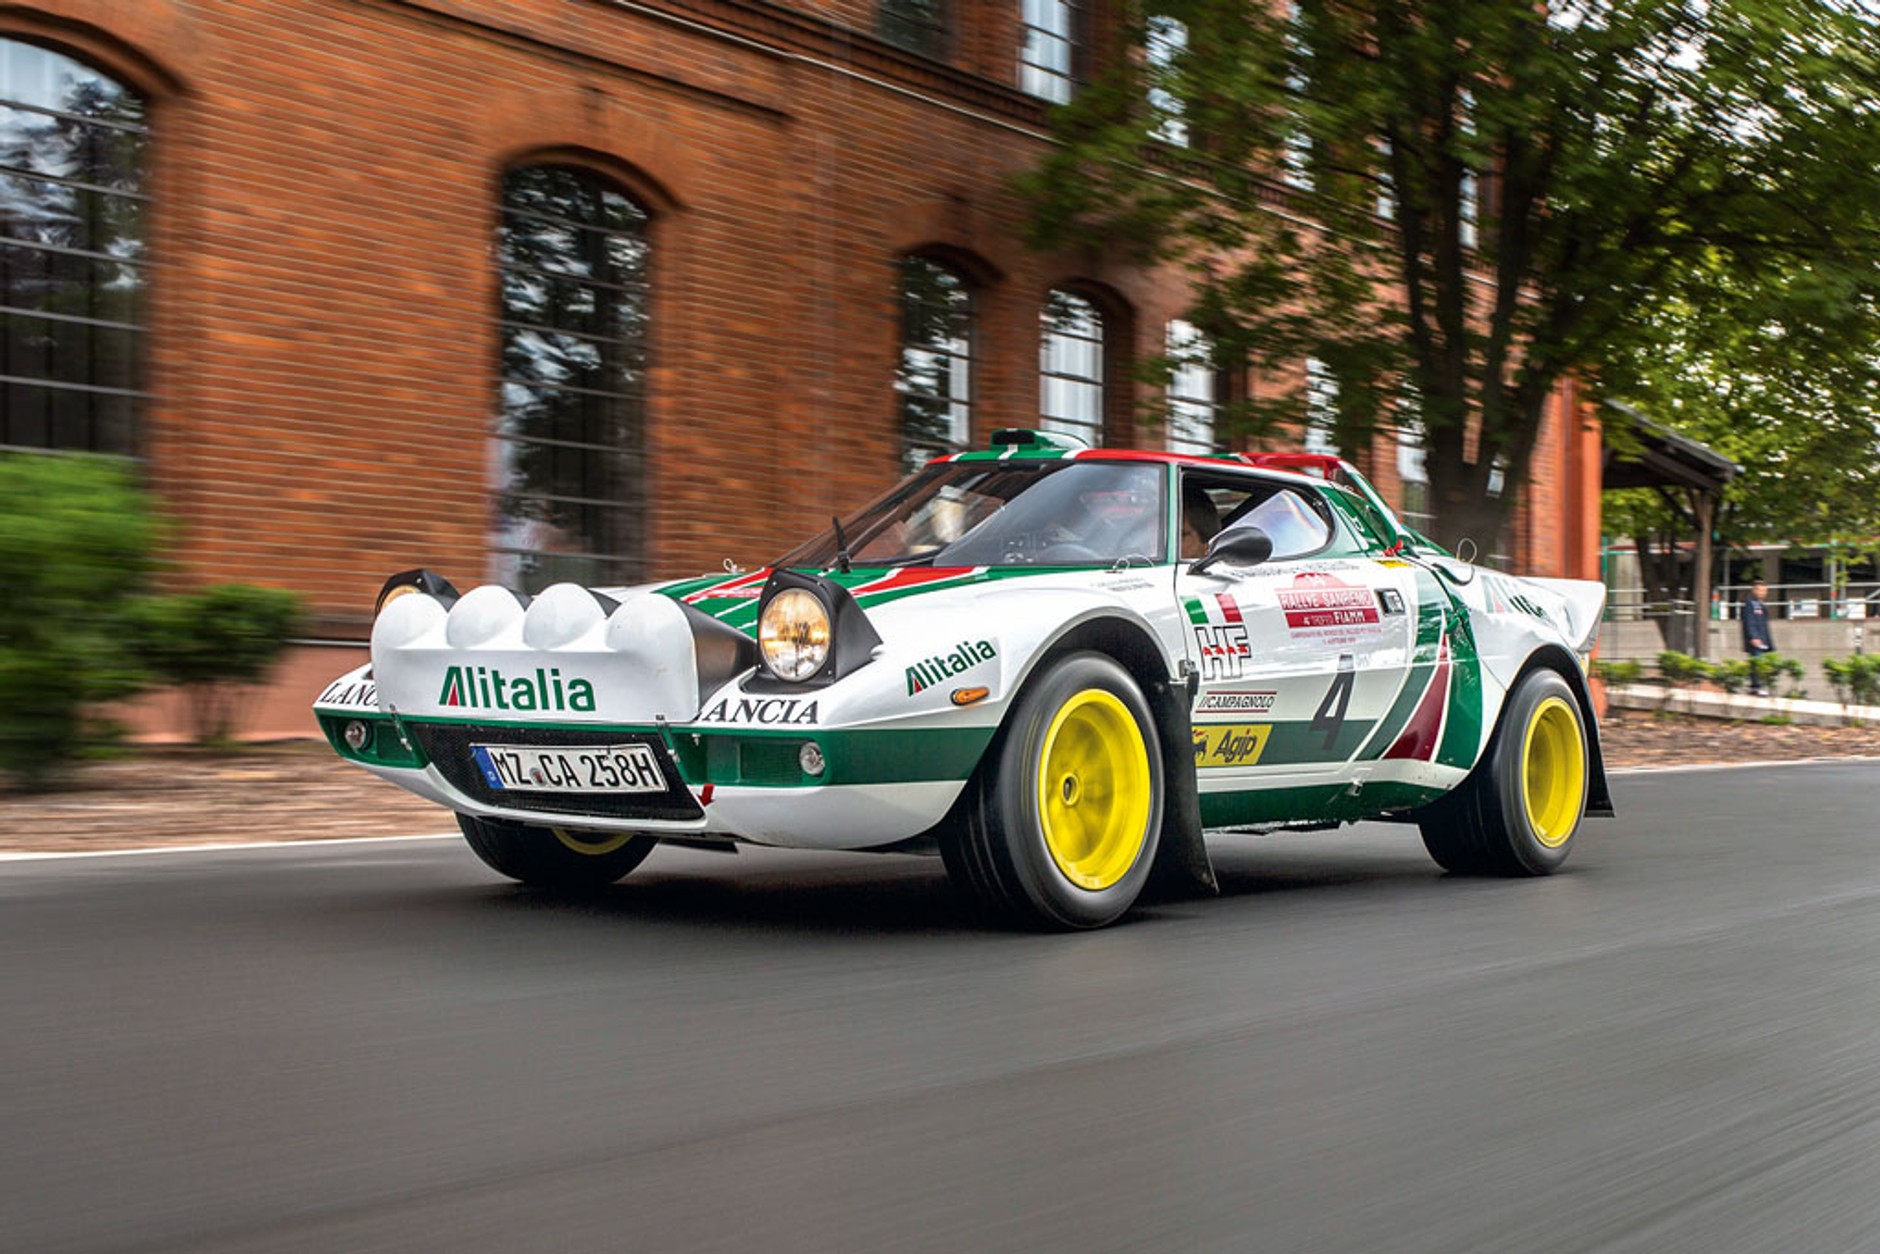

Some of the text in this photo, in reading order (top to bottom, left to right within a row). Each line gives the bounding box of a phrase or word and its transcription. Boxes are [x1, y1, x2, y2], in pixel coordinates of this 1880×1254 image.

[1280, 592, 1319, 609] RALLYE
[1333, 610, 1365, 624] FIAMM
[905, 640, 997, 697] Alitalia
[1194, 625, 1252, 681] HF
[318, 682, 379, 706] LANC
[438, 665, 597, 712] Alitalia
[1309, 653, 1355, 751] 4
[693, 698, 819, 724] ANCIA
[1213, 729, 1258, 763] Agip
[490, 752, 665, 788] MZ CA 258H
